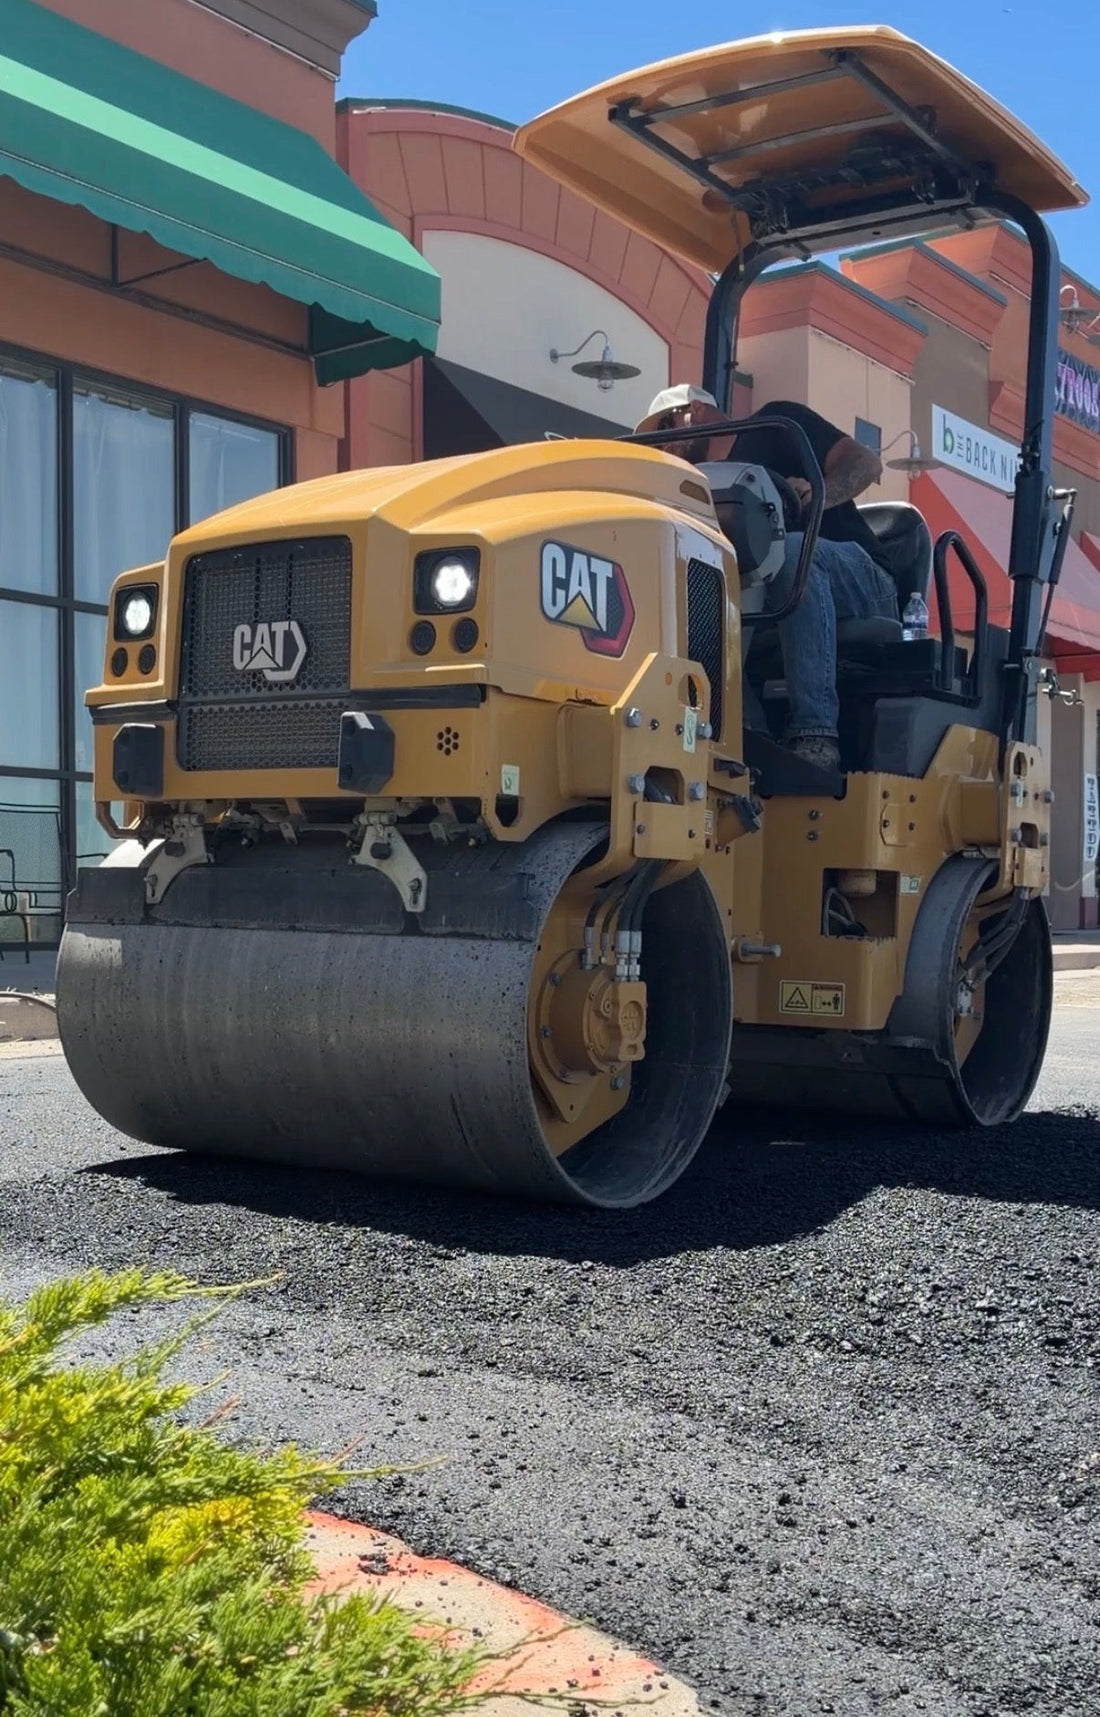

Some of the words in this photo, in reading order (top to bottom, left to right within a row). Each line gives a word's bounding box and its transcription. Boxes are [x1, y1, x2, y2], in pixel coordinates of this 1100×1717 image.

[966, 437, 996, 475] BACK
[542, 543, 613, 632] CAT
[233, 621, 289, 670] CAT
